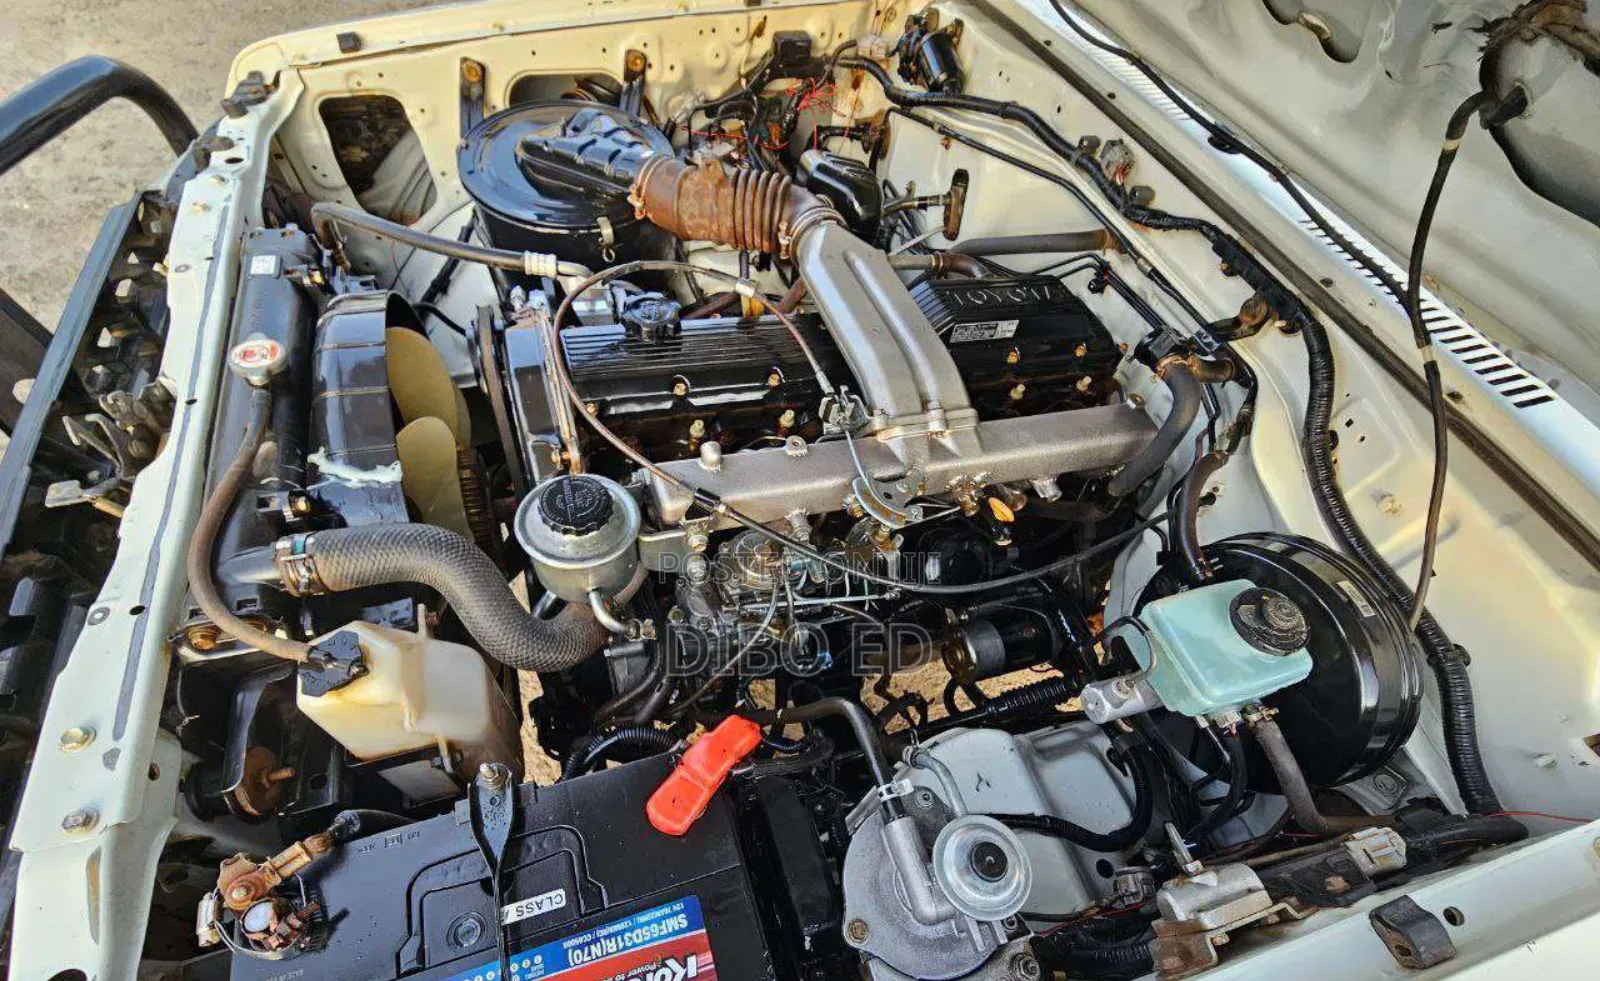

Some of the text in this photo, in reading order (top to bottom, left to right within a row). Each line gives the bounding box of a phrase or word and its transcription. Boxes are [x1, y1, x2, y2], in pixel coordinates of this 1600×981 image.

[515, 893, 564, 917] CLASS
[568, 913, 688, 967] SMF65D31R(N70)
[626, 954, 697, 981] Kor
[627, 961, 657, 977] Power
